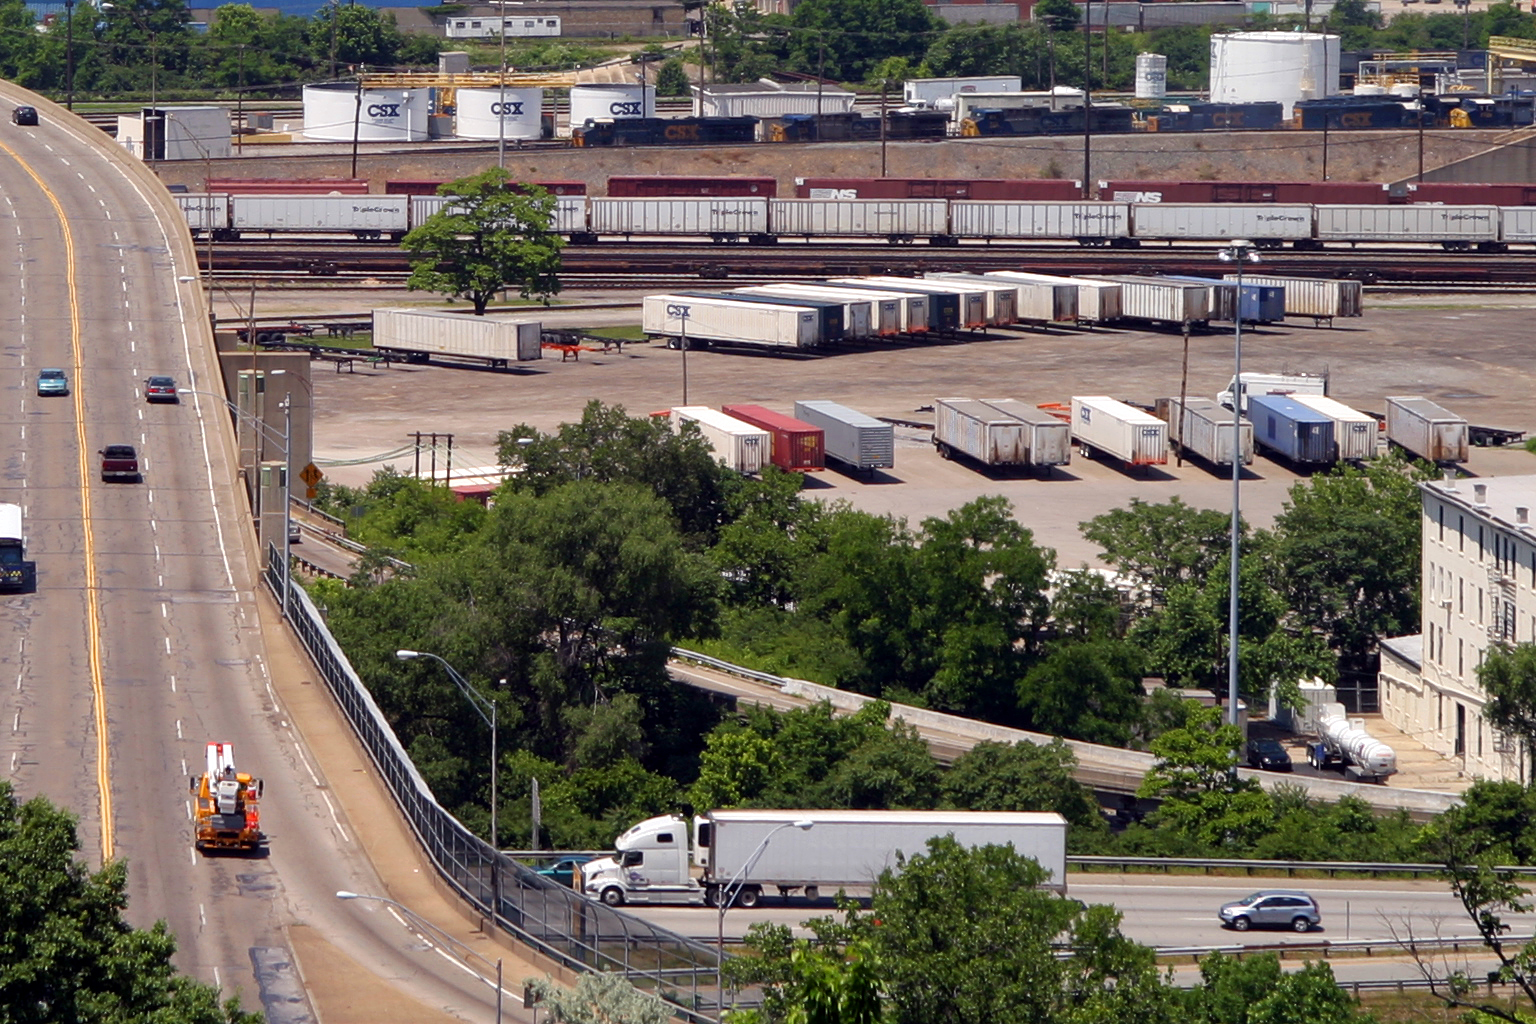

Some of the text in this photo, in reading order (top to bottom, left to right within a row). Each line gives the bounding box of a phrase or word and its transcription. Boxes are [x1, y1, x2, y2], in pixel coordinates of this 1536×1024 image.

[367, 103, 401, 117] CSX
[490, 101, 524, 116] CSX
[609, 101, 642, 116] CSX
[1341, 113, 1373, 127] CSX
[665, 124, 700, 140] CSX
[830, 189, 857, 200] NS
[1135, 191, 1162, 203] NS
[353, 206, 400, 214] TrpleCrown
[711, 209, 759, 217] TrpleCrown
[1073, 213, 1122, 221] TrpleCrown
[1257, 215, 1305, 223] TrpleCrown
[1440, 214, 1489, 222] TrpleCrown
[666, 303, 692, 317] CSX
